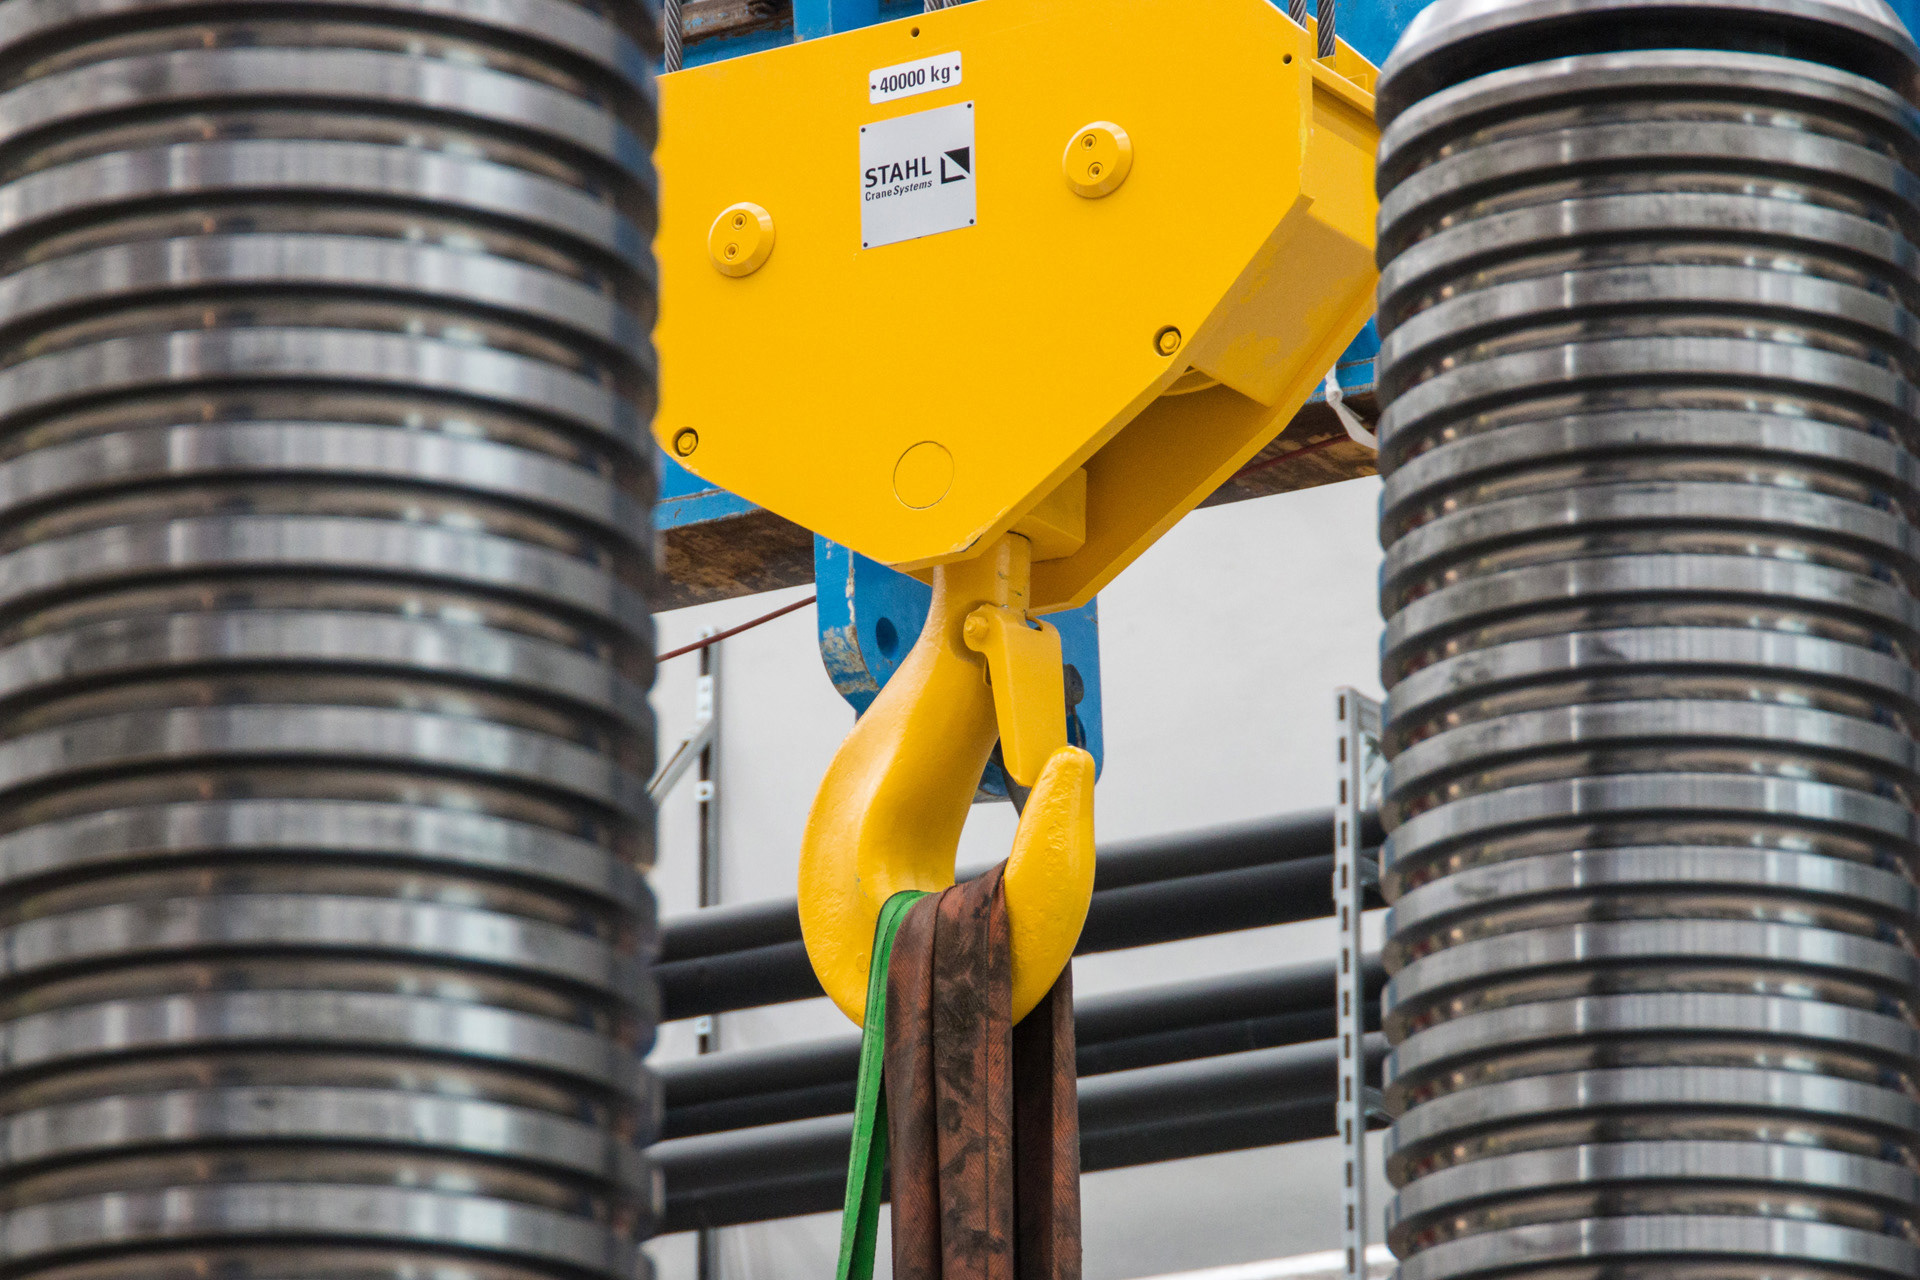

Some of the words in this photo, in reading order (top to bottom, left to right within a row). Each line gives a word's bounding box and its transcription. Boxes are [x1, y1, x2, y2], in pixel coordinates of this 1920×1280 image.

[880, 69, 926, 93] 40000
[930, 65, 950, 84] kg
[865, 156, 932, 188] STAHL
